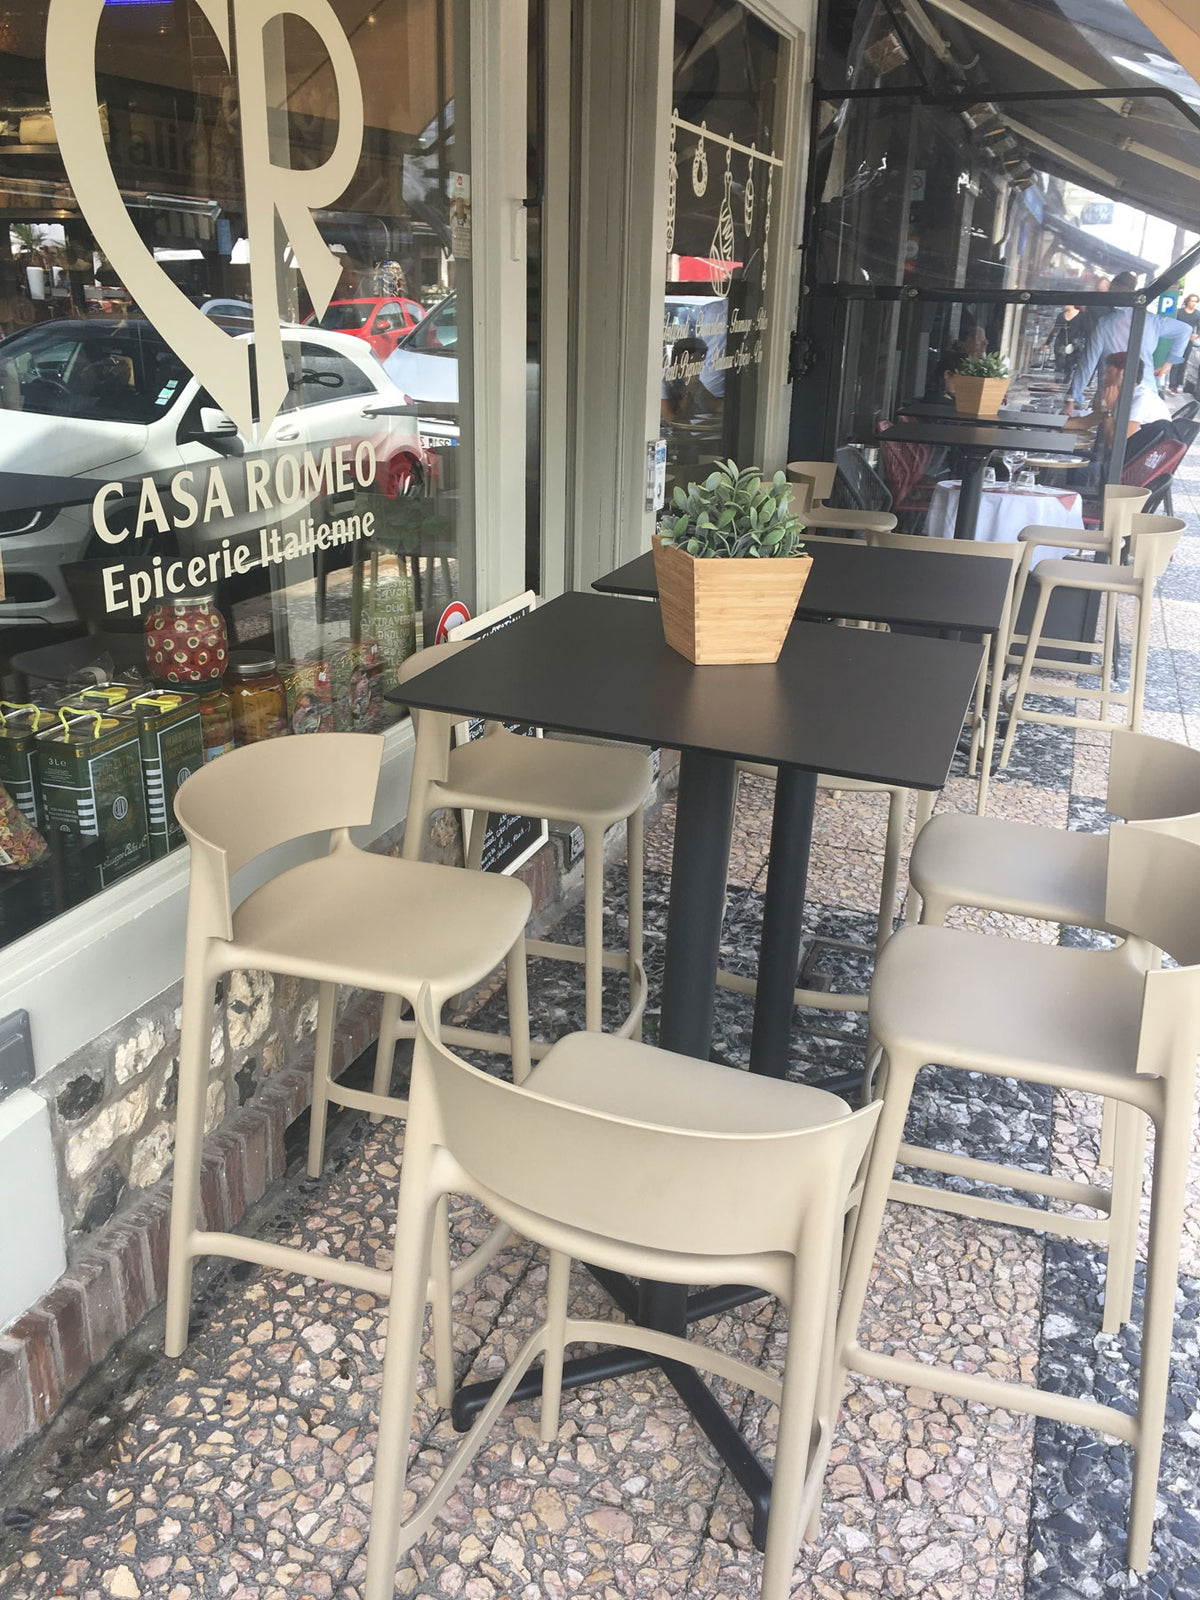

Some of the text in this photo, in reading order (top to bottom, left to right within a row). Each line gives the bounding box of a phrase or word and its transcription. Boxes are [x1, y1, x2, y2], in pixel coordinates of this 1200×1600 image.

[1161, 297, 1174, 313] P
[93, 440, 378, 545] CASA ROMEO
[101, 510, 376, 617] Epicerie Italienne
